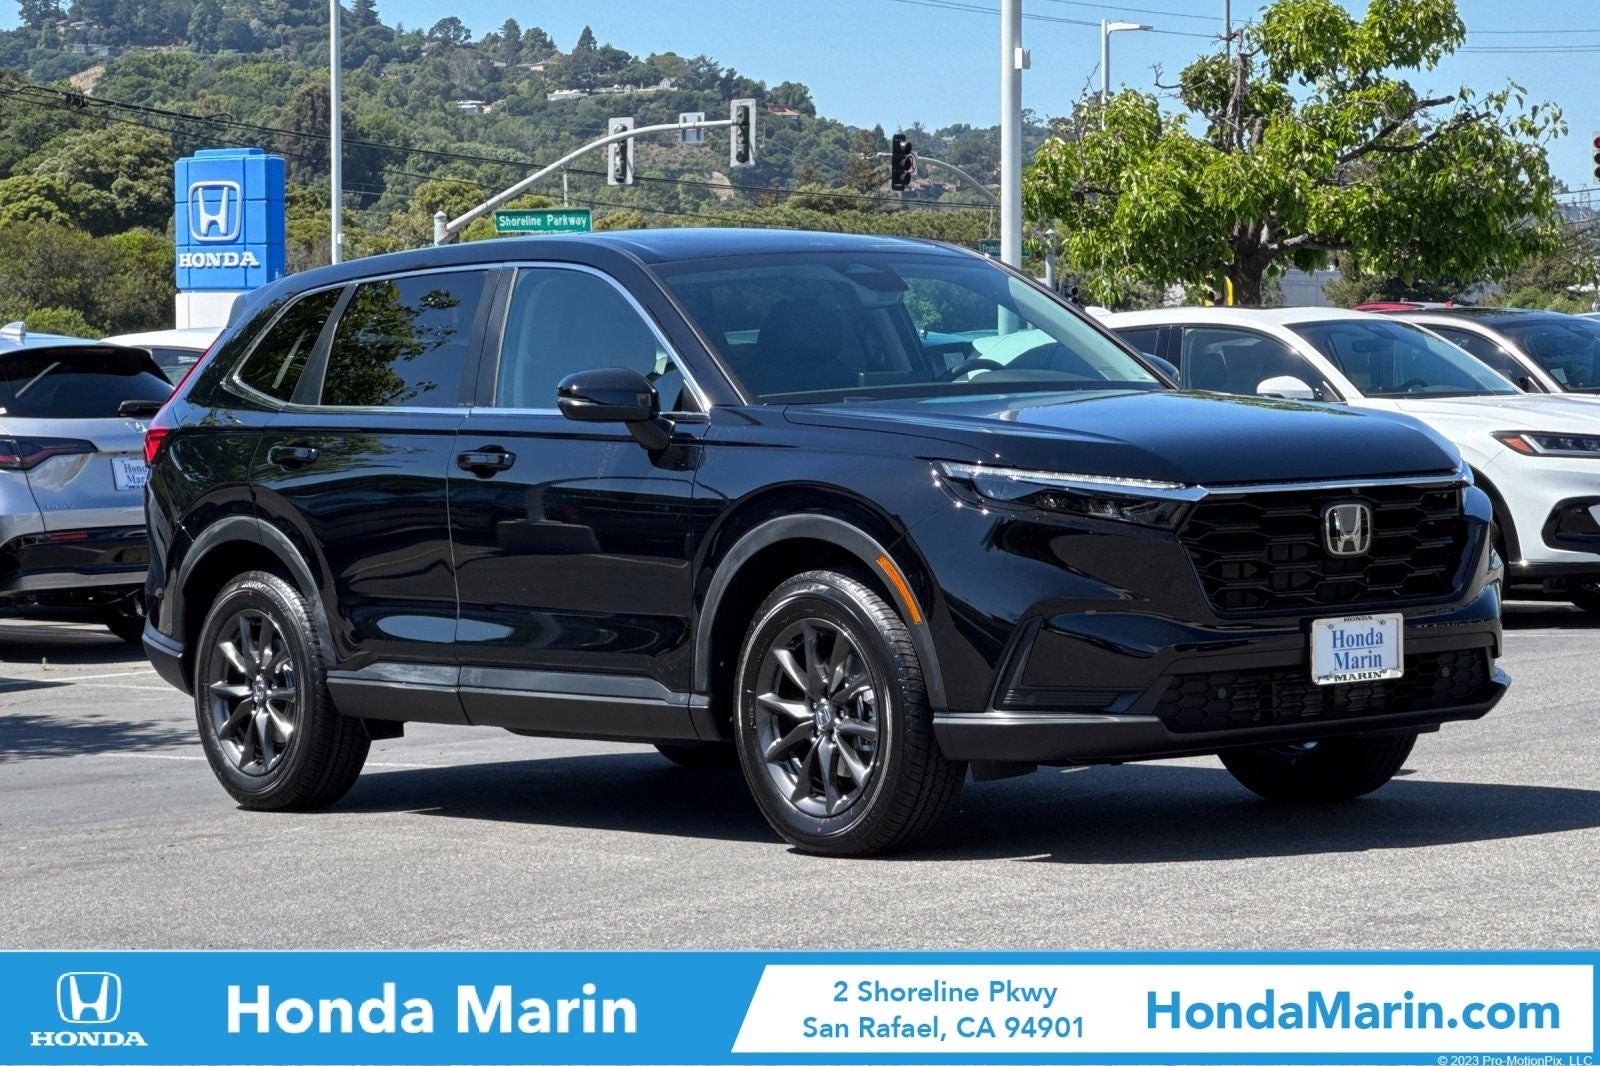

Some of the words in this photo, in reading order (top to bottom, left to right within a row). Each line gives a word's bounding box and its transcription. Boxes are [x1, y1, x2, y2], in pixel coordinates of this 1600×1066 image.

[499, 215, 541, 227] Shoreline
[546, 214, 587, 227] Parkway
[178, 251, 260, 268] HONDA
[127, 474, 146, 484] Mar
[1331, 627, 1384, 649] Honda
[1333, 650, 1383, 671] Marin
[1334, 671, 1382, 682] MARIN
